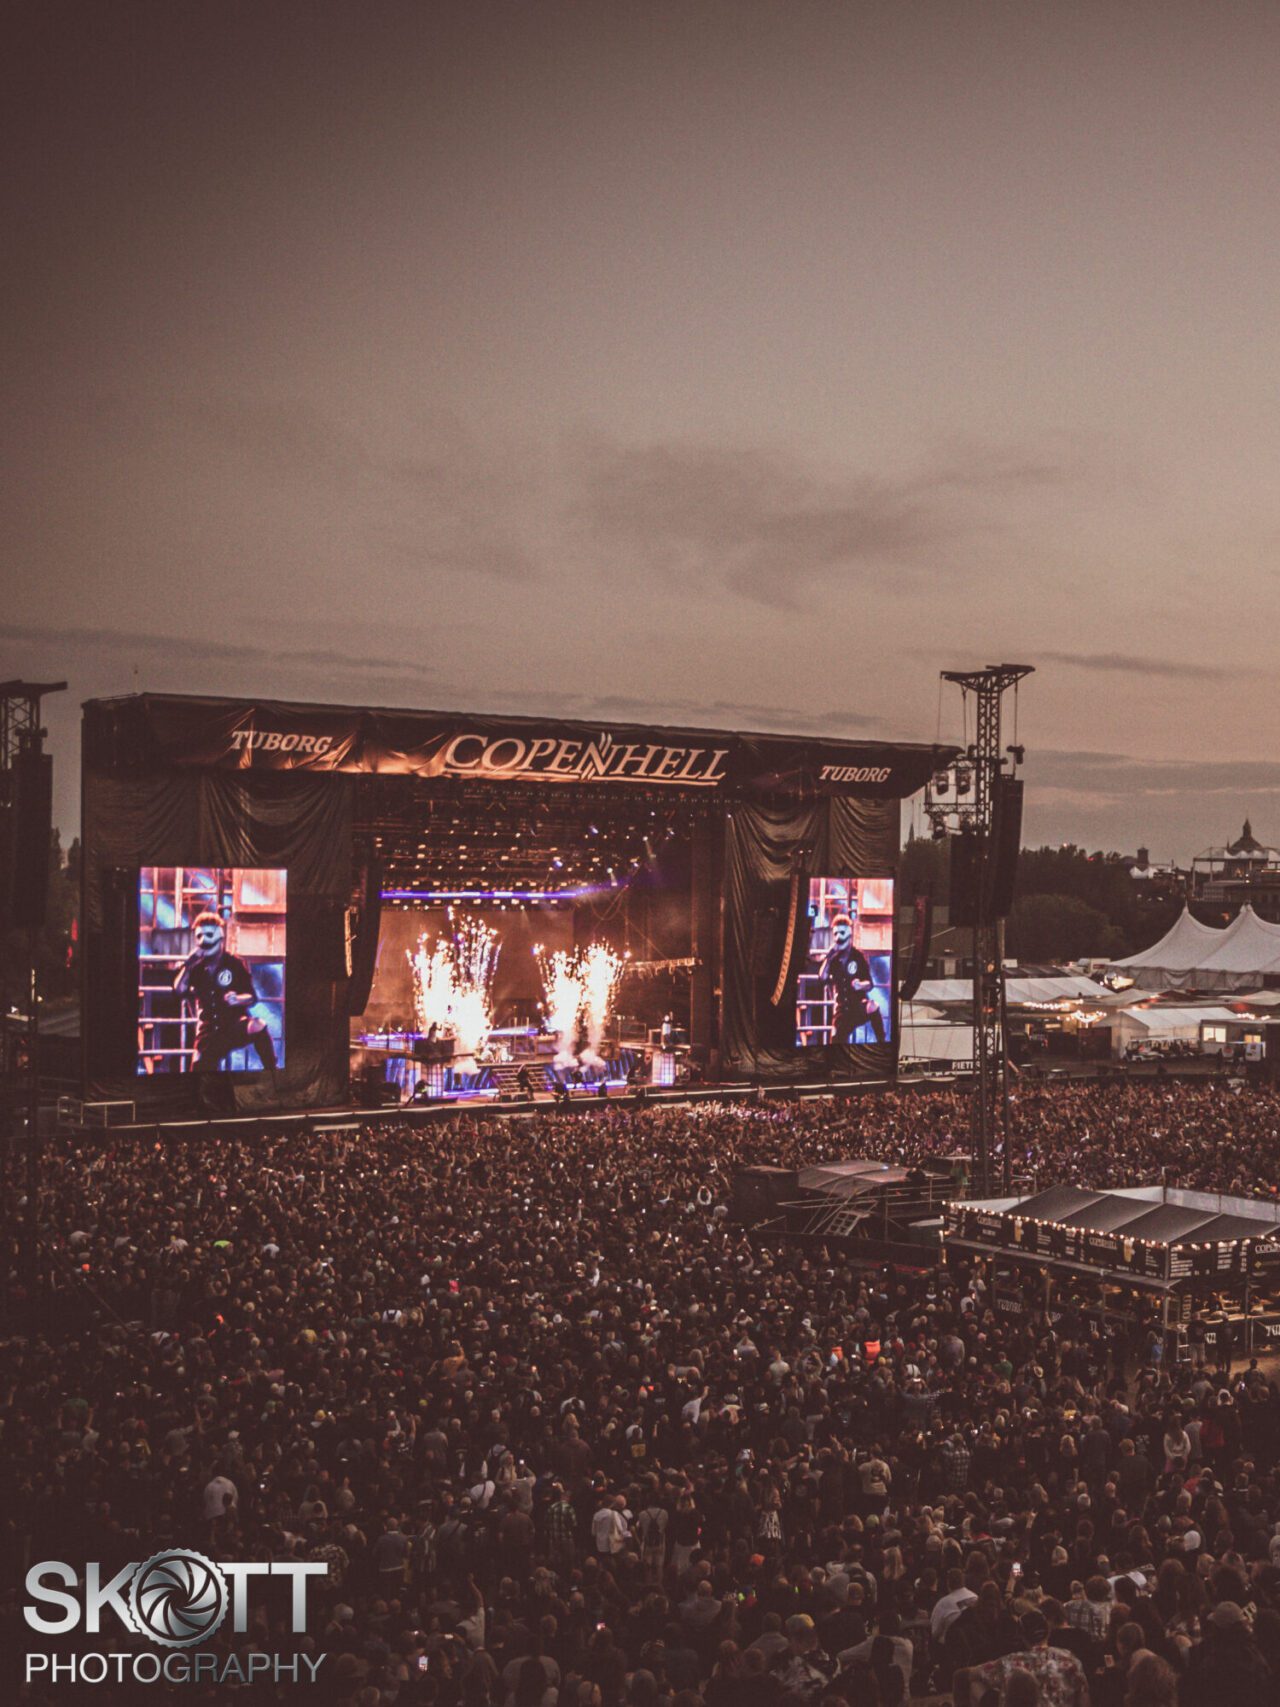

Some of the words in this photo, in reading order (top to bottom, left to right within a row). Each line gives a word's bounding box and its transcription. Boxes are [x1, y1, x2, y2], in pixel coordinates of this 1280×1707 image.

[230, 730, 332, 755] TUBORG
[445, 731, 729, 785] COPENHELL
[819, 765, 892, 783] TUBORG
